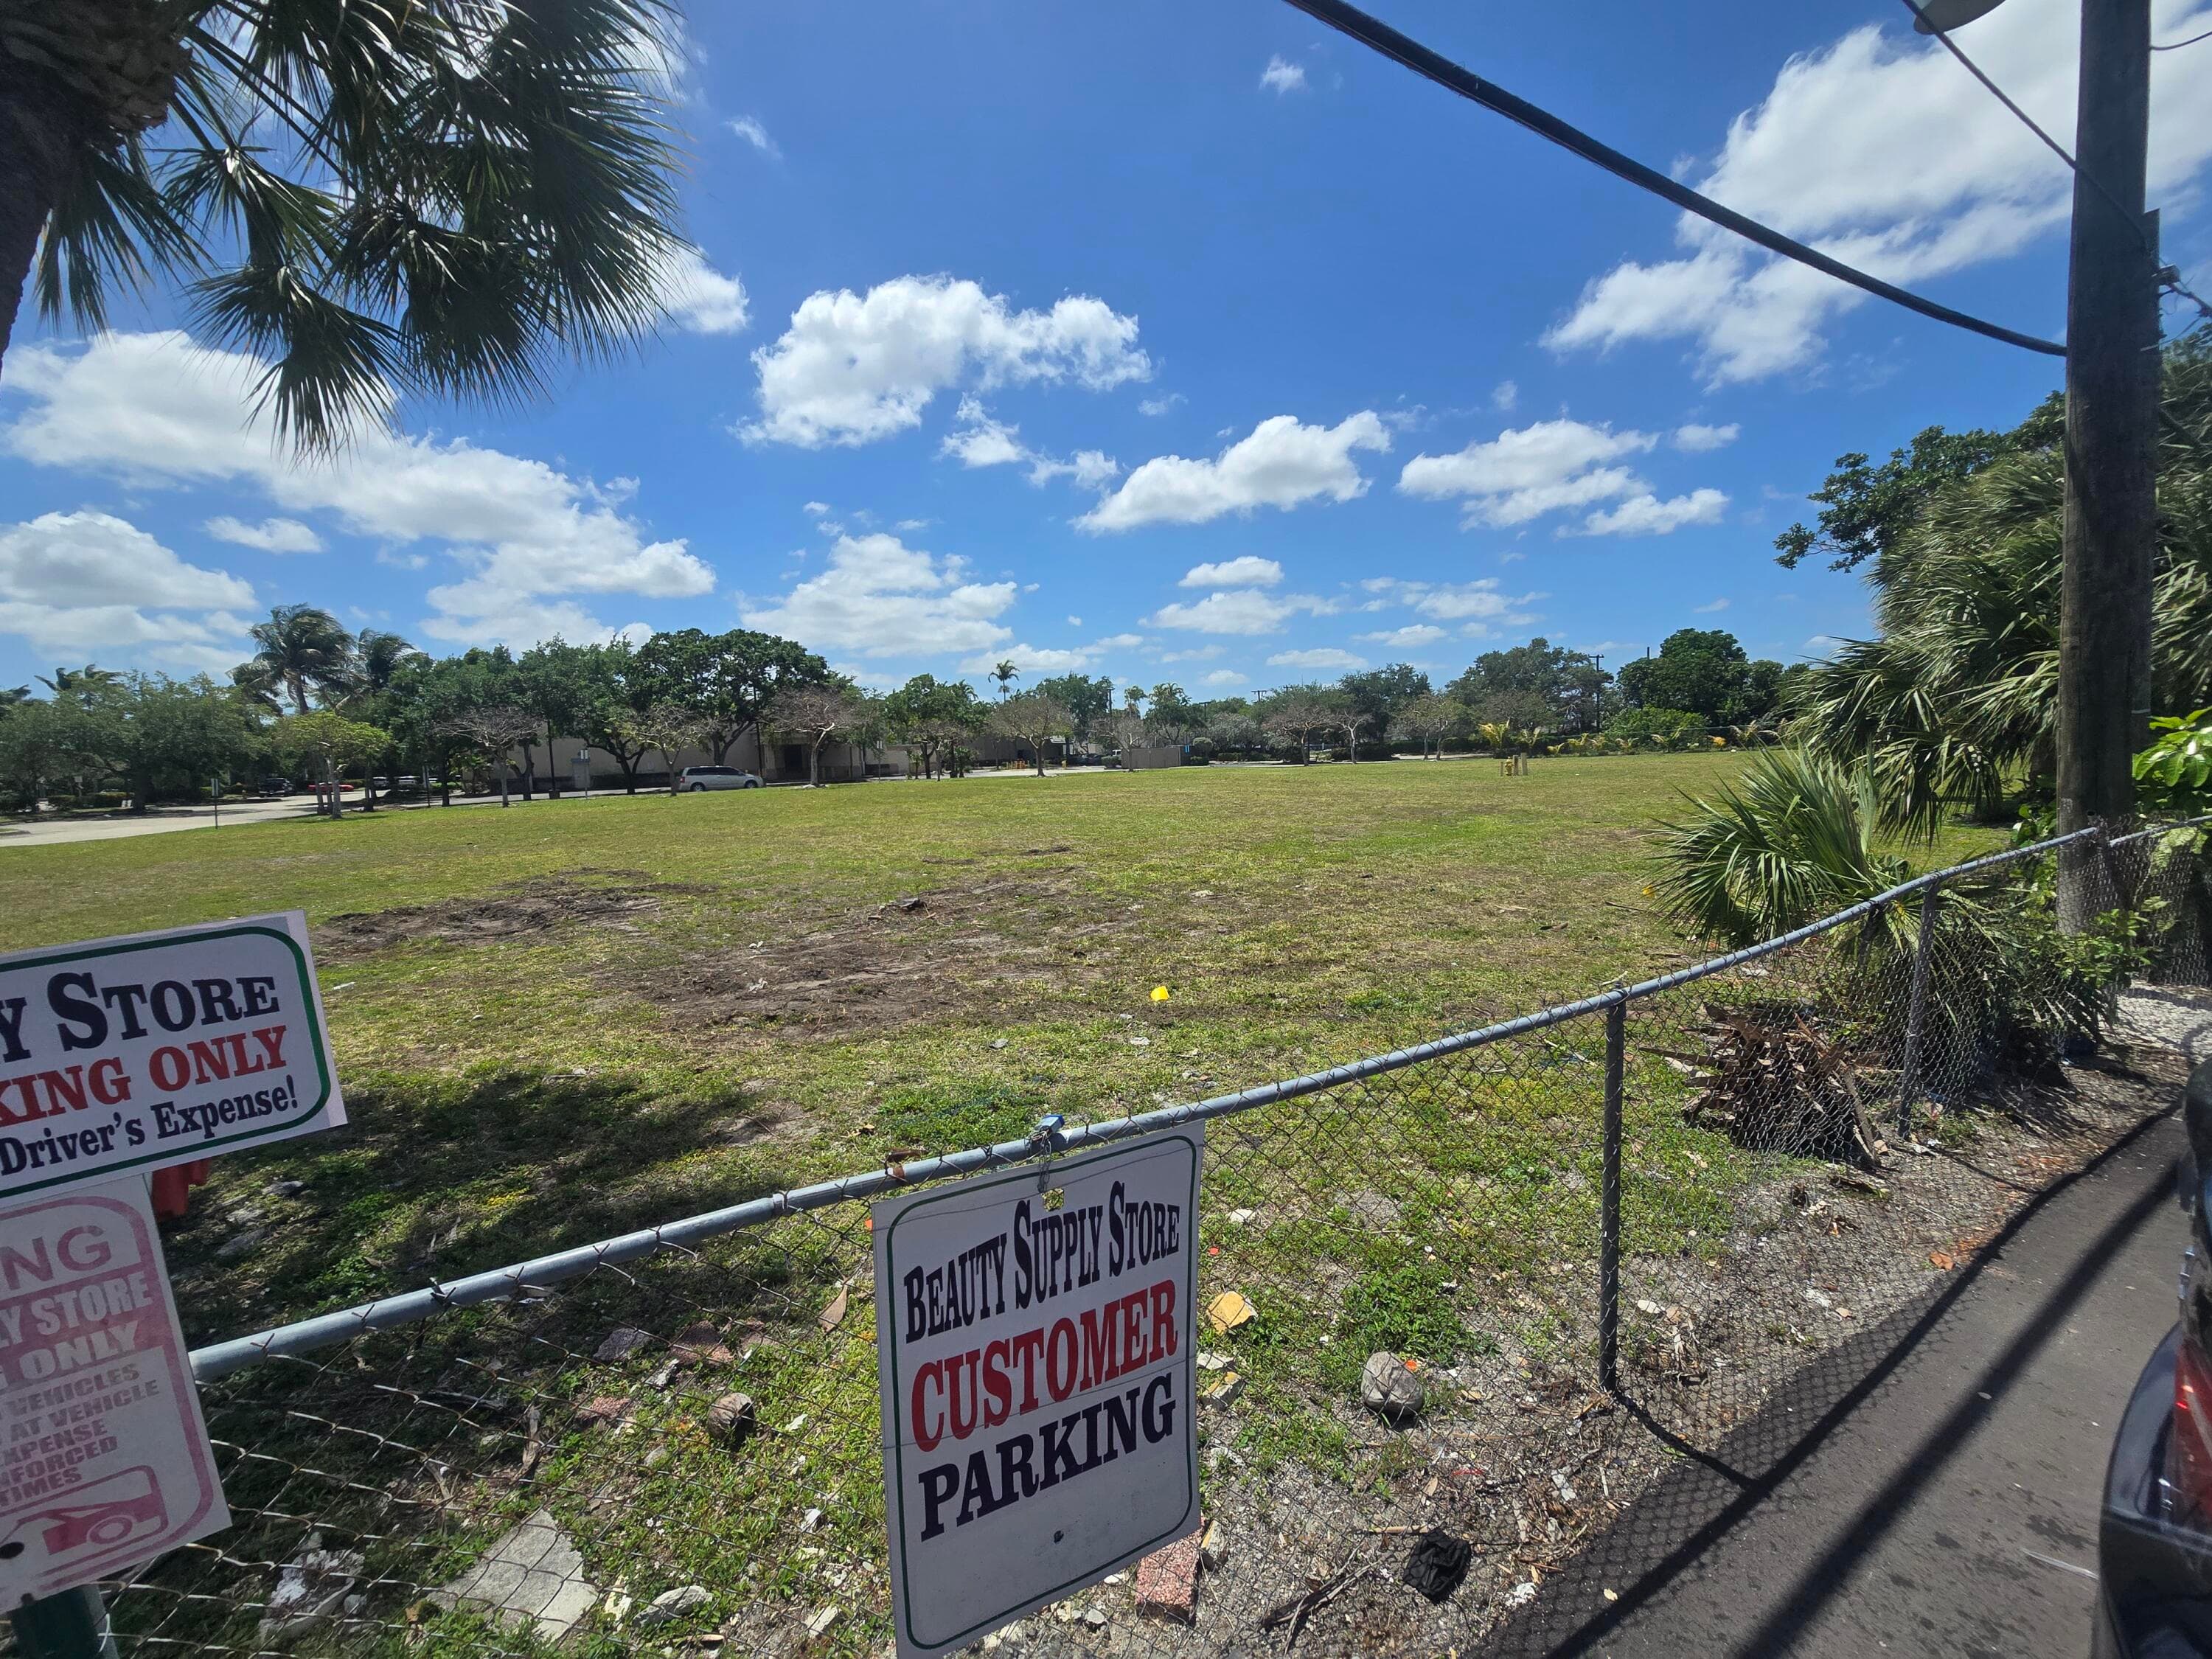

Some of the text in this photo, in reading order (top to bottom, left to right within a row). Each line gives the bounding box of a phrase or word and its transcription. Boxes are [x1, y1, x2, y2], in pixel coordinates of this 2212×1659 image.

[47, 972, 280, 1051] STORE
[149, 1025, 288, 1093] ONLY
[0, 1074, 298, 1175] Driver's Expense!
[903, 1180, 1180, 1344] BEAUTY SUPPLY STORE
[31, 1270, 153, 1335] STORE
[19, 1320, 139, 1379] ONLY
[911, 1279, 1178, 1453] CUSTOMER
[7, 1363, 140, 1416] VEHICLES
[10, 1379, 160, 1442] AT VEHICLE
[0, 1418, 108, 1467] XPENSE
[917, 1371, 1176, 1543] PARKING
